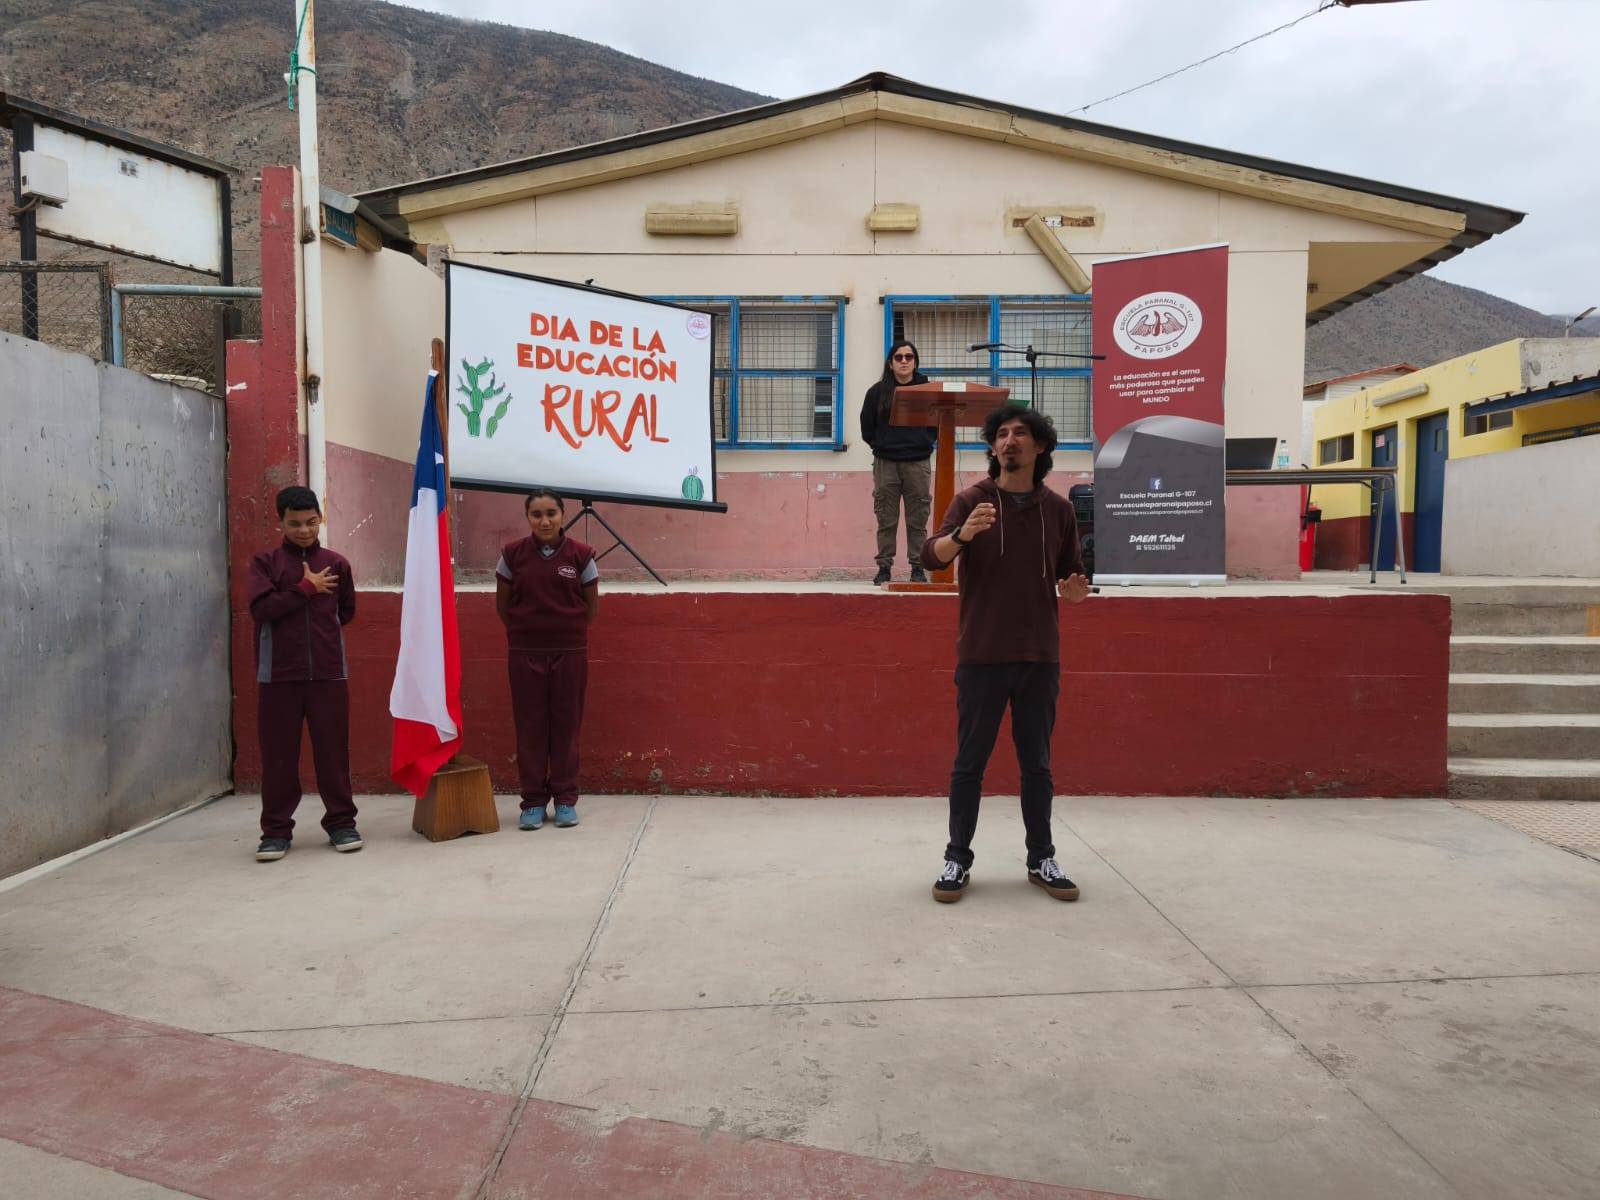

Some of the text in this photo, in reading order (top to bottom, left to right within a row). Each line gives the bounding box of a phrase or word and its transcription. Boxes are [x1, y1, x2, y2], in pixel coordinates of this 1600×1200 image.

[1120, 304, 1143, 331] ESCUELA
[530, 312, 666, 353] DIA DE LA
[1134, 341, 1179, 353] PAPOSO
[517, 343, 677, 383] EDUCACIÓN
[1122, 370, 1160, 380] educación
[1126, 379, 1160, 389] poderosa
[1162, 379, 1176, 387] que
[1177, 376, 1205, 385] puedes
[1136, 389, 1153, 397] para
[1154, 386, 1186, 394] cambiar
[1143, 395, 1170, 404] MUNDO
[540, 383, 670, 453] RURAL
[1105, 500, 1212, 509] www.escuelaparanalpaposo.cl
[1129, 534, 1185, 543] DAEM Taltal
